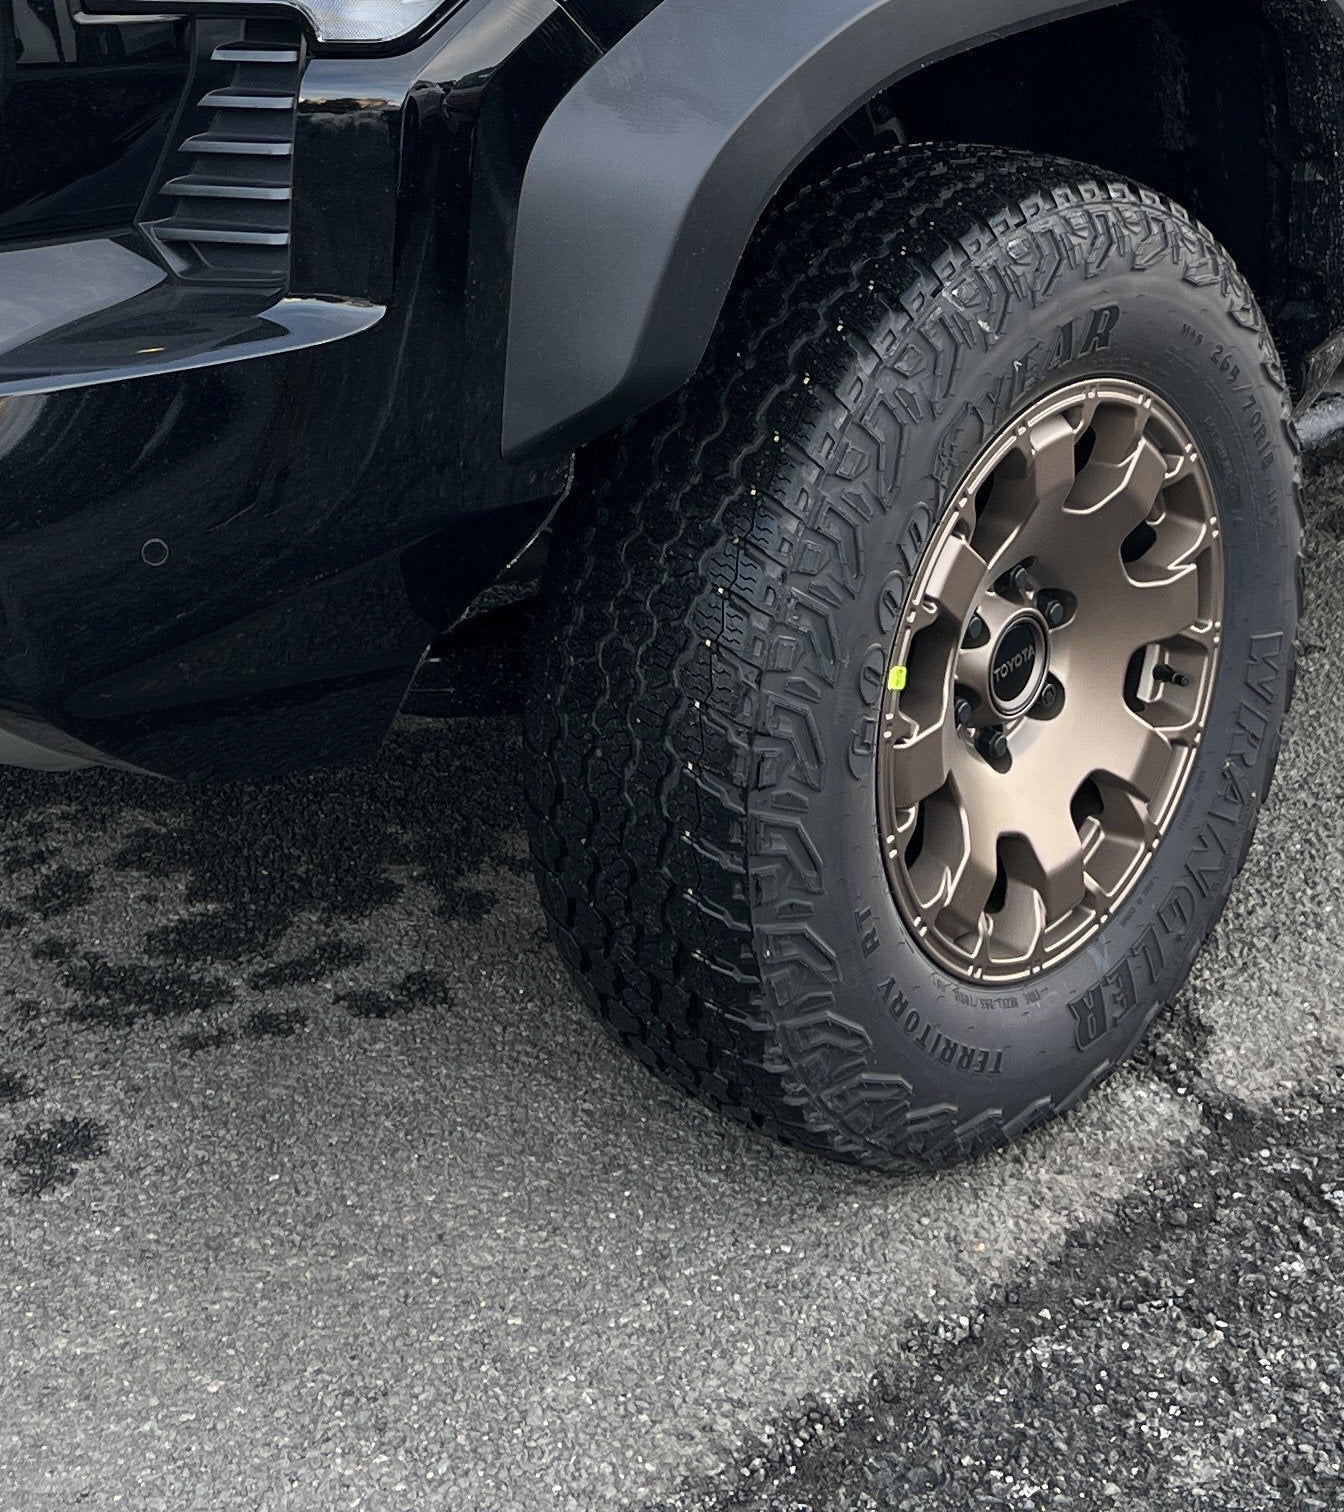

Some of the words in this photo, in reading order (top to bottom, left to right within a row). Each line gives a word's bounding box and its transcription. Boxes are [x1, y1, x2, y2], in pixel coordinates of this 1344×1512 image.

[993, 644, 1036, 683] TOYOTA
[1066, 630, 1285, 1053] WRANGLER
[876, 975, 1004, 1076] TERRITORY
